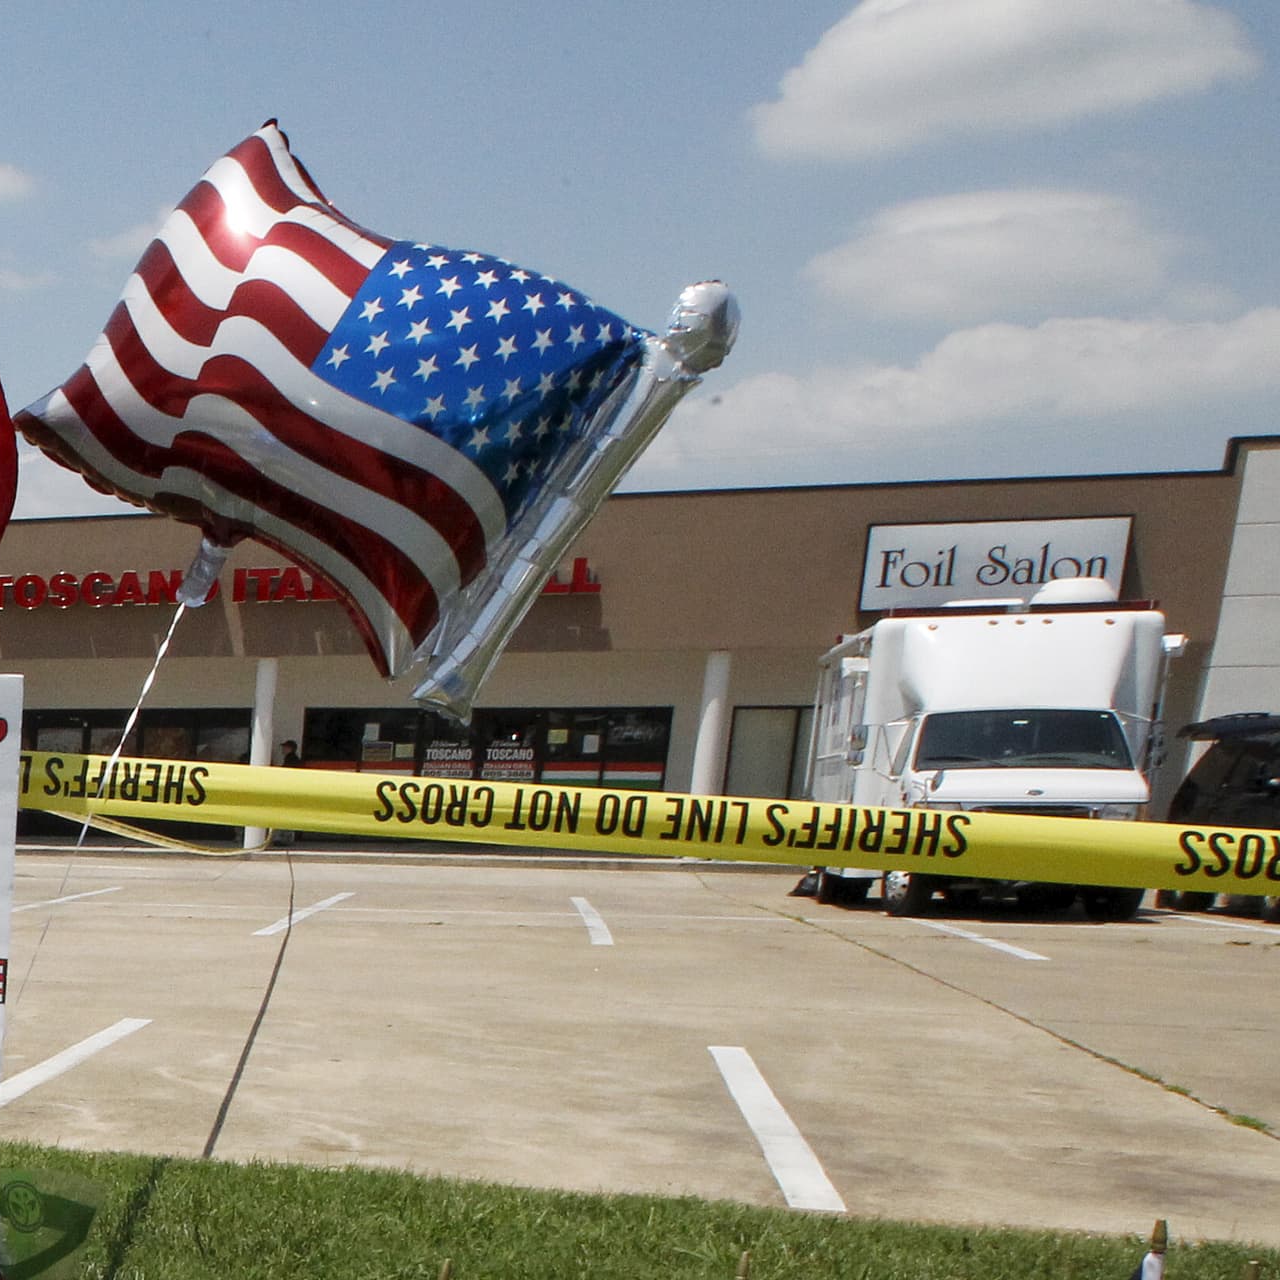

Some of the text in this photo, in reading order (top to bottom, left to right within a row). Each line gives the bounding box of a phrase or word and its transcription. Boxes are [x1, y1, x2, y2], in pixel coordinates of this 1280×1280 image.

[875, 542, 1107, 588] Foil Salon
[426, 748, 472, 760] TOSCANO
[486, 748, 534, 760] TOSCANO
[43, 756, 209, 806] SHERIFF'S
[373, 780, 971, 858] SHERIFF'S LINE DO NOT CROSS
[1174, 830, 1280, 882] ROSS
